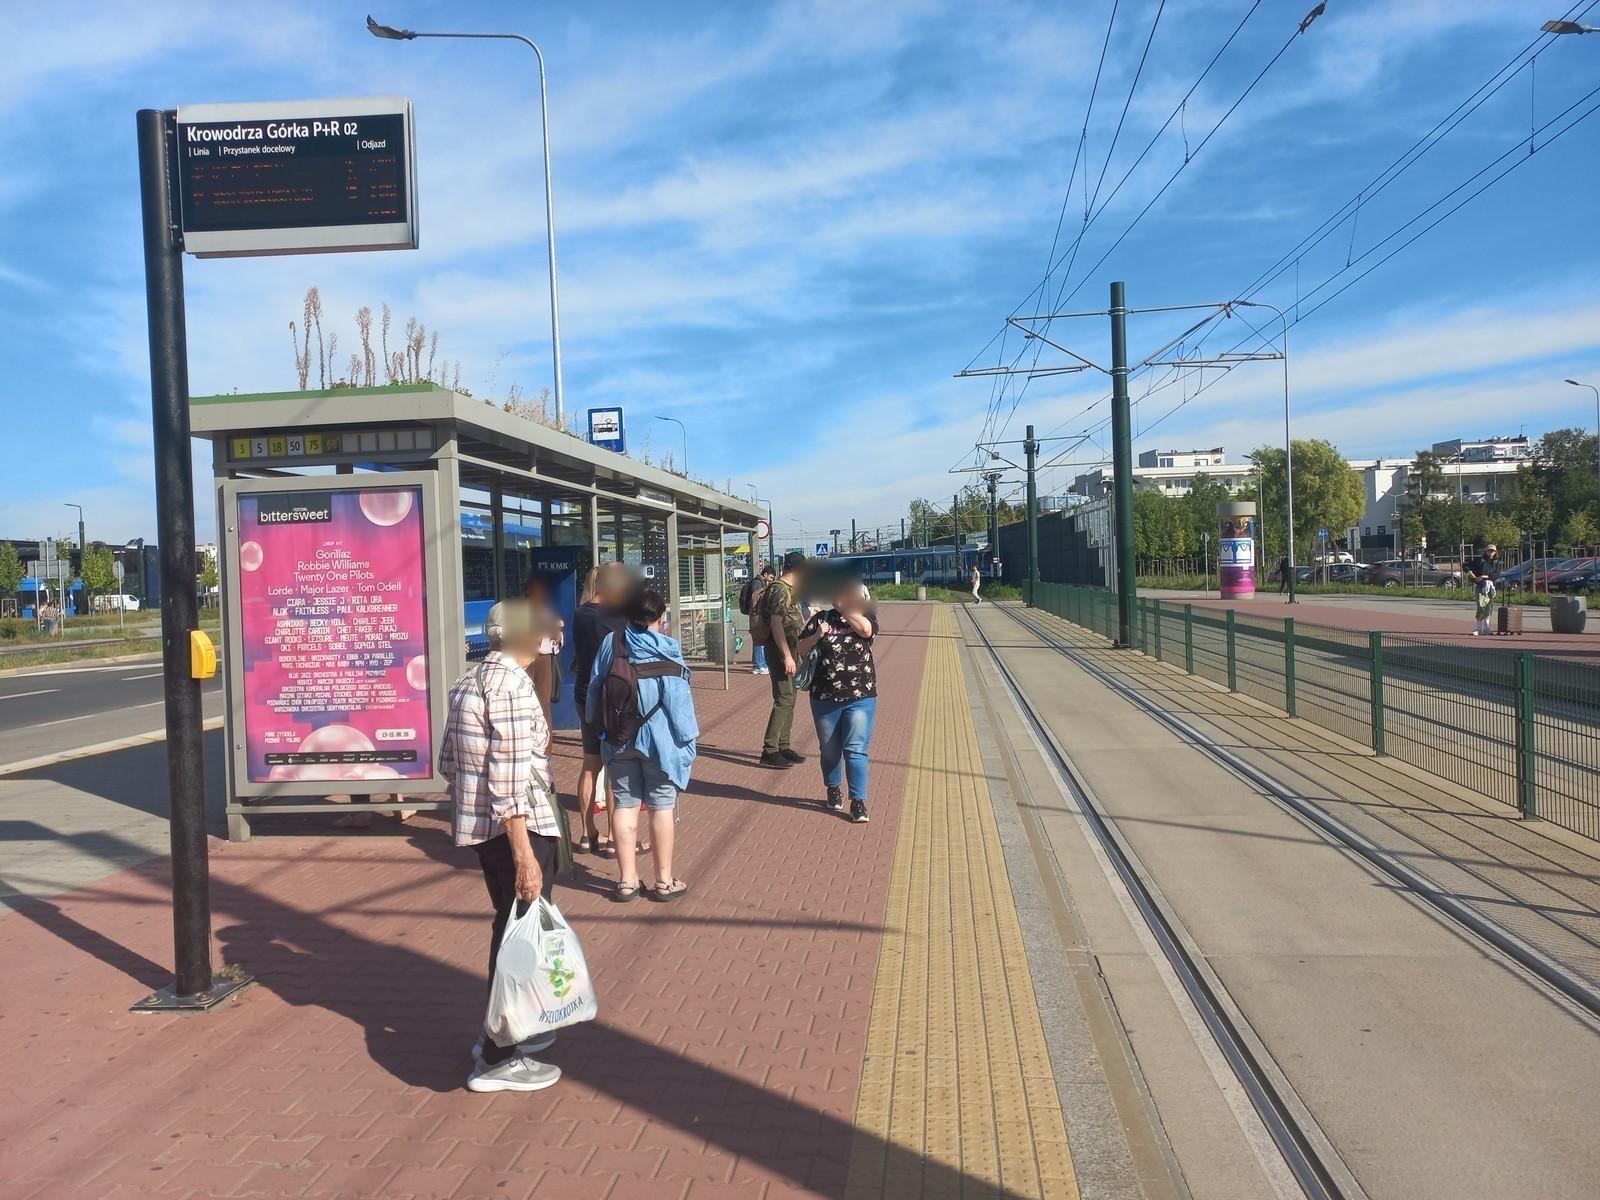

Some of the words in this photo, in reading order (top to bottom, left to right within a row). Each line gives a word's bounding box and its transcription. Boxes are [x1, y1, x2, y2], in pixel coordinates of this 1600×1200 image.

[187, 125, 263, 142] Krowodrza
[267, 122, 309, 138] Górka
[313, 121, 340, 136] P+R
[344, 123, 358, 135] 02
[223, 145, 261, 156] Przystanek
[262, 145, 295, 154] docelowy
[361, 140, 386, 149] Odjazd
[193, 147, 209, 156] Linia
[240, 444, 245, 454] 3
[257, 443, 262, 453] 5
[272, 442, 282, 452] 18
[290, 441, 300, 451] 50
[309, 440, 319, 450] 75
[261, 509, 329, 522] bittersweet
[316, 548, 351, 560] Gorillaz
[298, 561, 330, 571] Robbie
[331, 558, 370, 570] Williams
[294, 571, 325, 584] Twenty
[326, 570, 348, 581] One
[350, 569, 374, 580] Pilots
[268, 585, 293, 596] Lorde
[301, 584, 324, 596] Major
[325, 583, 350, 594] Lazer
[357, 582, 376, 592] Tom
[377, 581, 401, 592] Odell
[287, 598, 306, 607] CIARA
[313, 597, 337, 606] JESSIE
[340, 596, 345, 605] J
[352, 596, 368, 604] RITA
[371, 595, 383, 603] ORA
[273, 608, 288, 616] ALOK
[295, 606, 330, 615] FAITHLESS
[337, 605, 353, 614] PAUL
[356, 603, 398, 613] KALKBRENNER
[310, 618, 328, 627] BECKY
[353, 617, 377, 625] CHARLIE
[275, 628, 306, 636] CHARLOTTE
[337, 626, 351, 634] CHET
